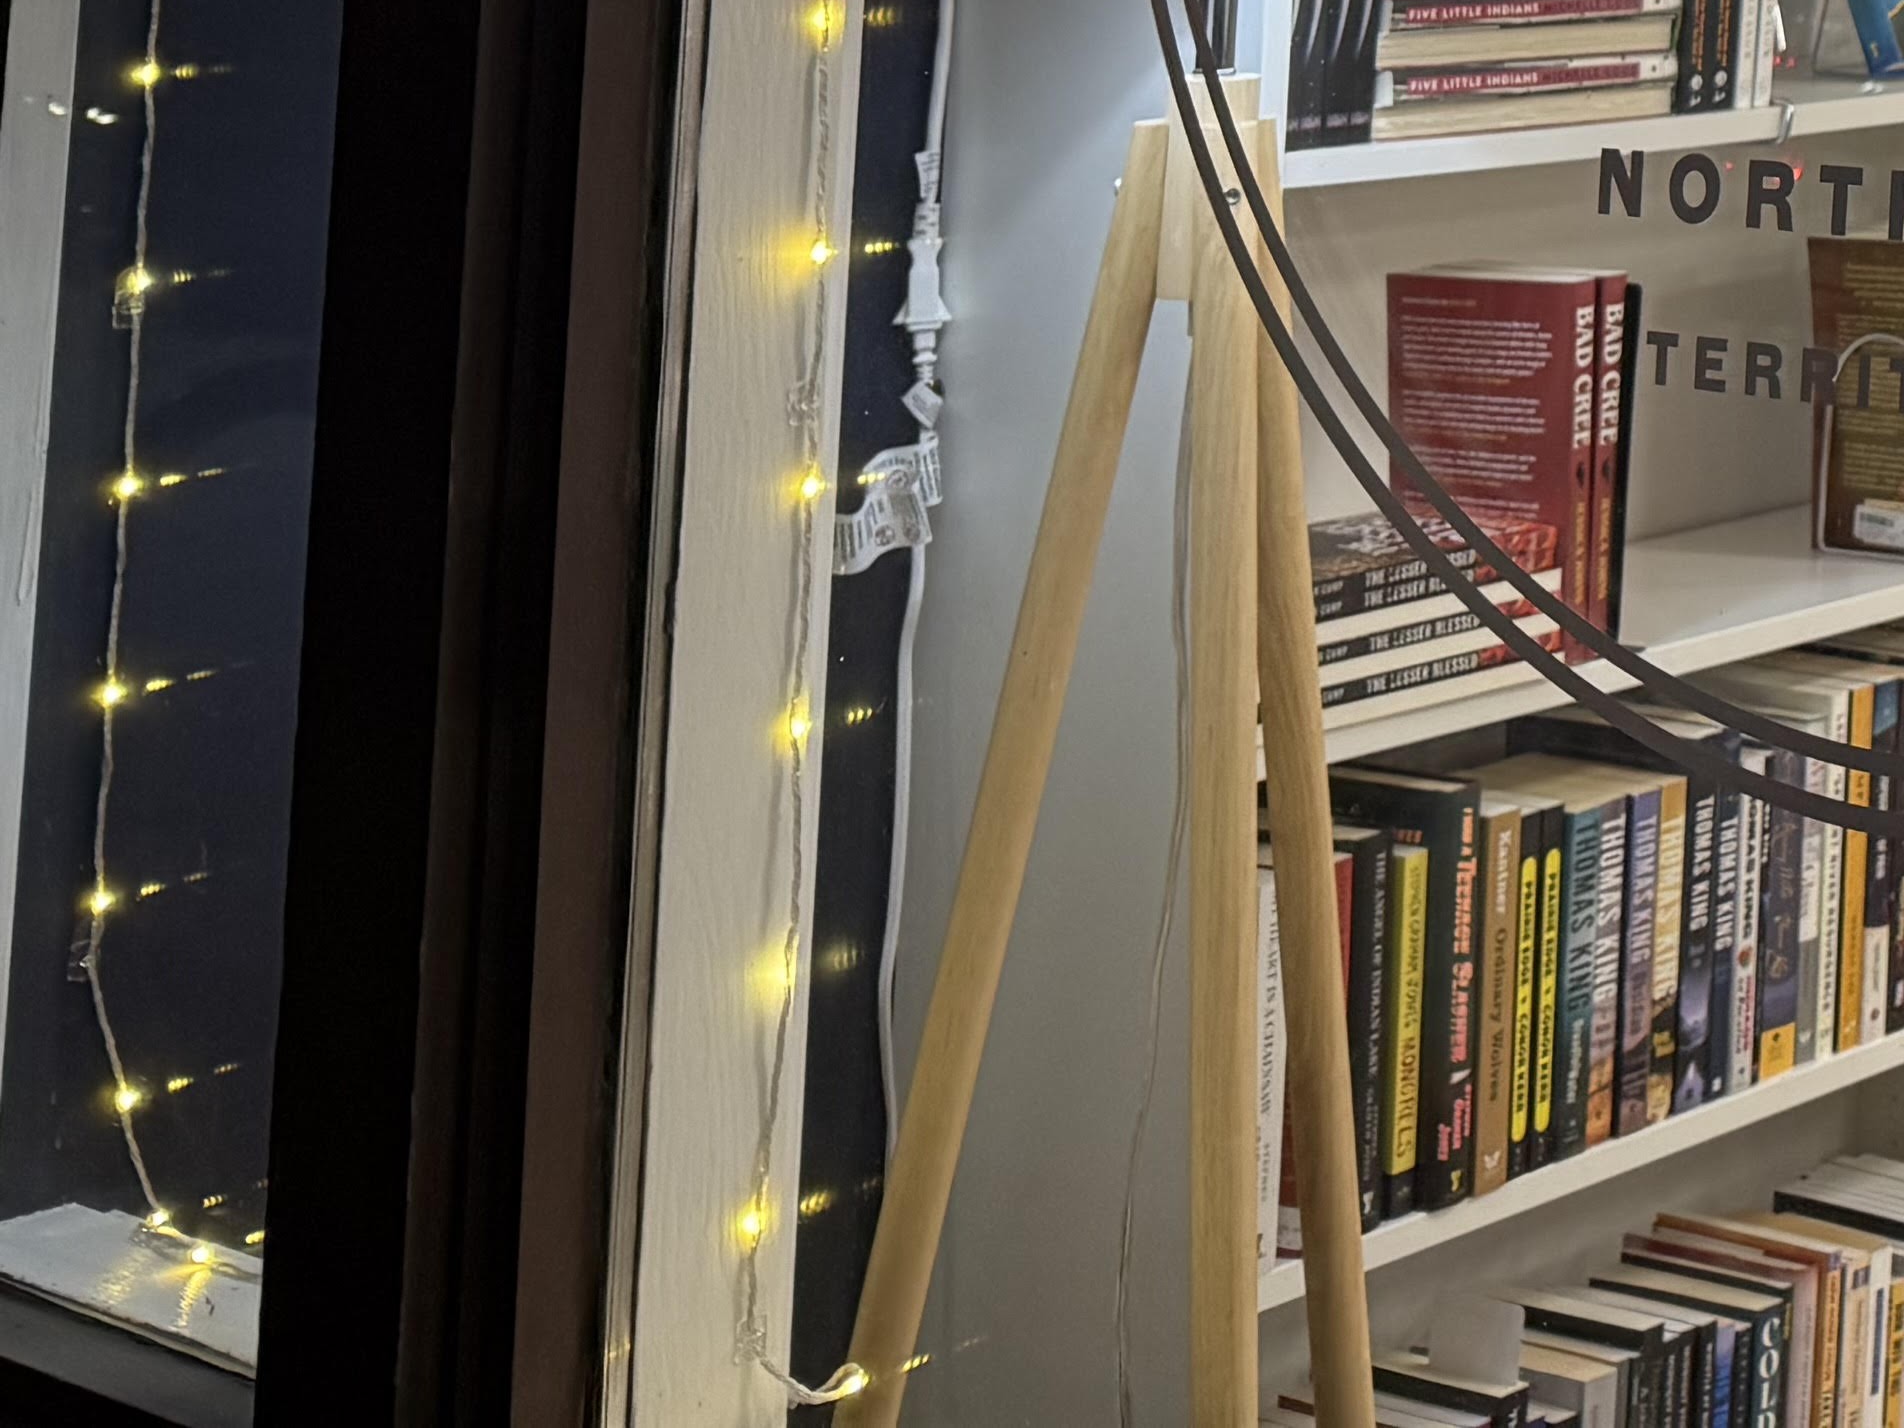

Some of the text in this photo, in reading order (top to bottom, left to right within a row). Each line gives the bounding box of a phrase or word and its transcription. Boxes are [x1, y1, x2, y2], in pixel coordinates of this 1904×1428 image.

[1408, 2, 1540, 22] FIVE LITTLE INDIANS
[1410, 72, 1538, 92] FIVE LITTLE INDIANS
[1572, 306, 1595, 449] BAD CREE
[1600, 302, 1624, 446] BAD CREE
[1364, 581, 1425, 608] THE LESSER
[1366, 562, 1427, 587] THE LESSER
[1369, 614, 1480, 650] THE LESSER BLESSED
[1367, 654, 1478, 693] THE LESSER BLESSED
[1631, 814, 1656, 964] THOMAS KING
[1689, 794, 1715, 931] THOMAS KING
[1714, 816, 1738, 951] THOMAS KING
[1567, 816, 1598, 1011] THOMAS KING
[1593, 813, 1626, 1001] THOMAS KING
[1654, 816, 1683, 1002] THOMAS KING
[1743, 874, 1756, 939] KING
[1489, 829, 1513, 1101] Kantner Ordinary Wolves
[1521, 946, 1532, 985] EDGE
[1544, 937, 1555, 977] EDGE
[1397, 1037, 1415, 1159] MONGRELS
[1516, 1072, 1526, 1113] KERR
[1539, 1061, 1550, 1103] KERR
